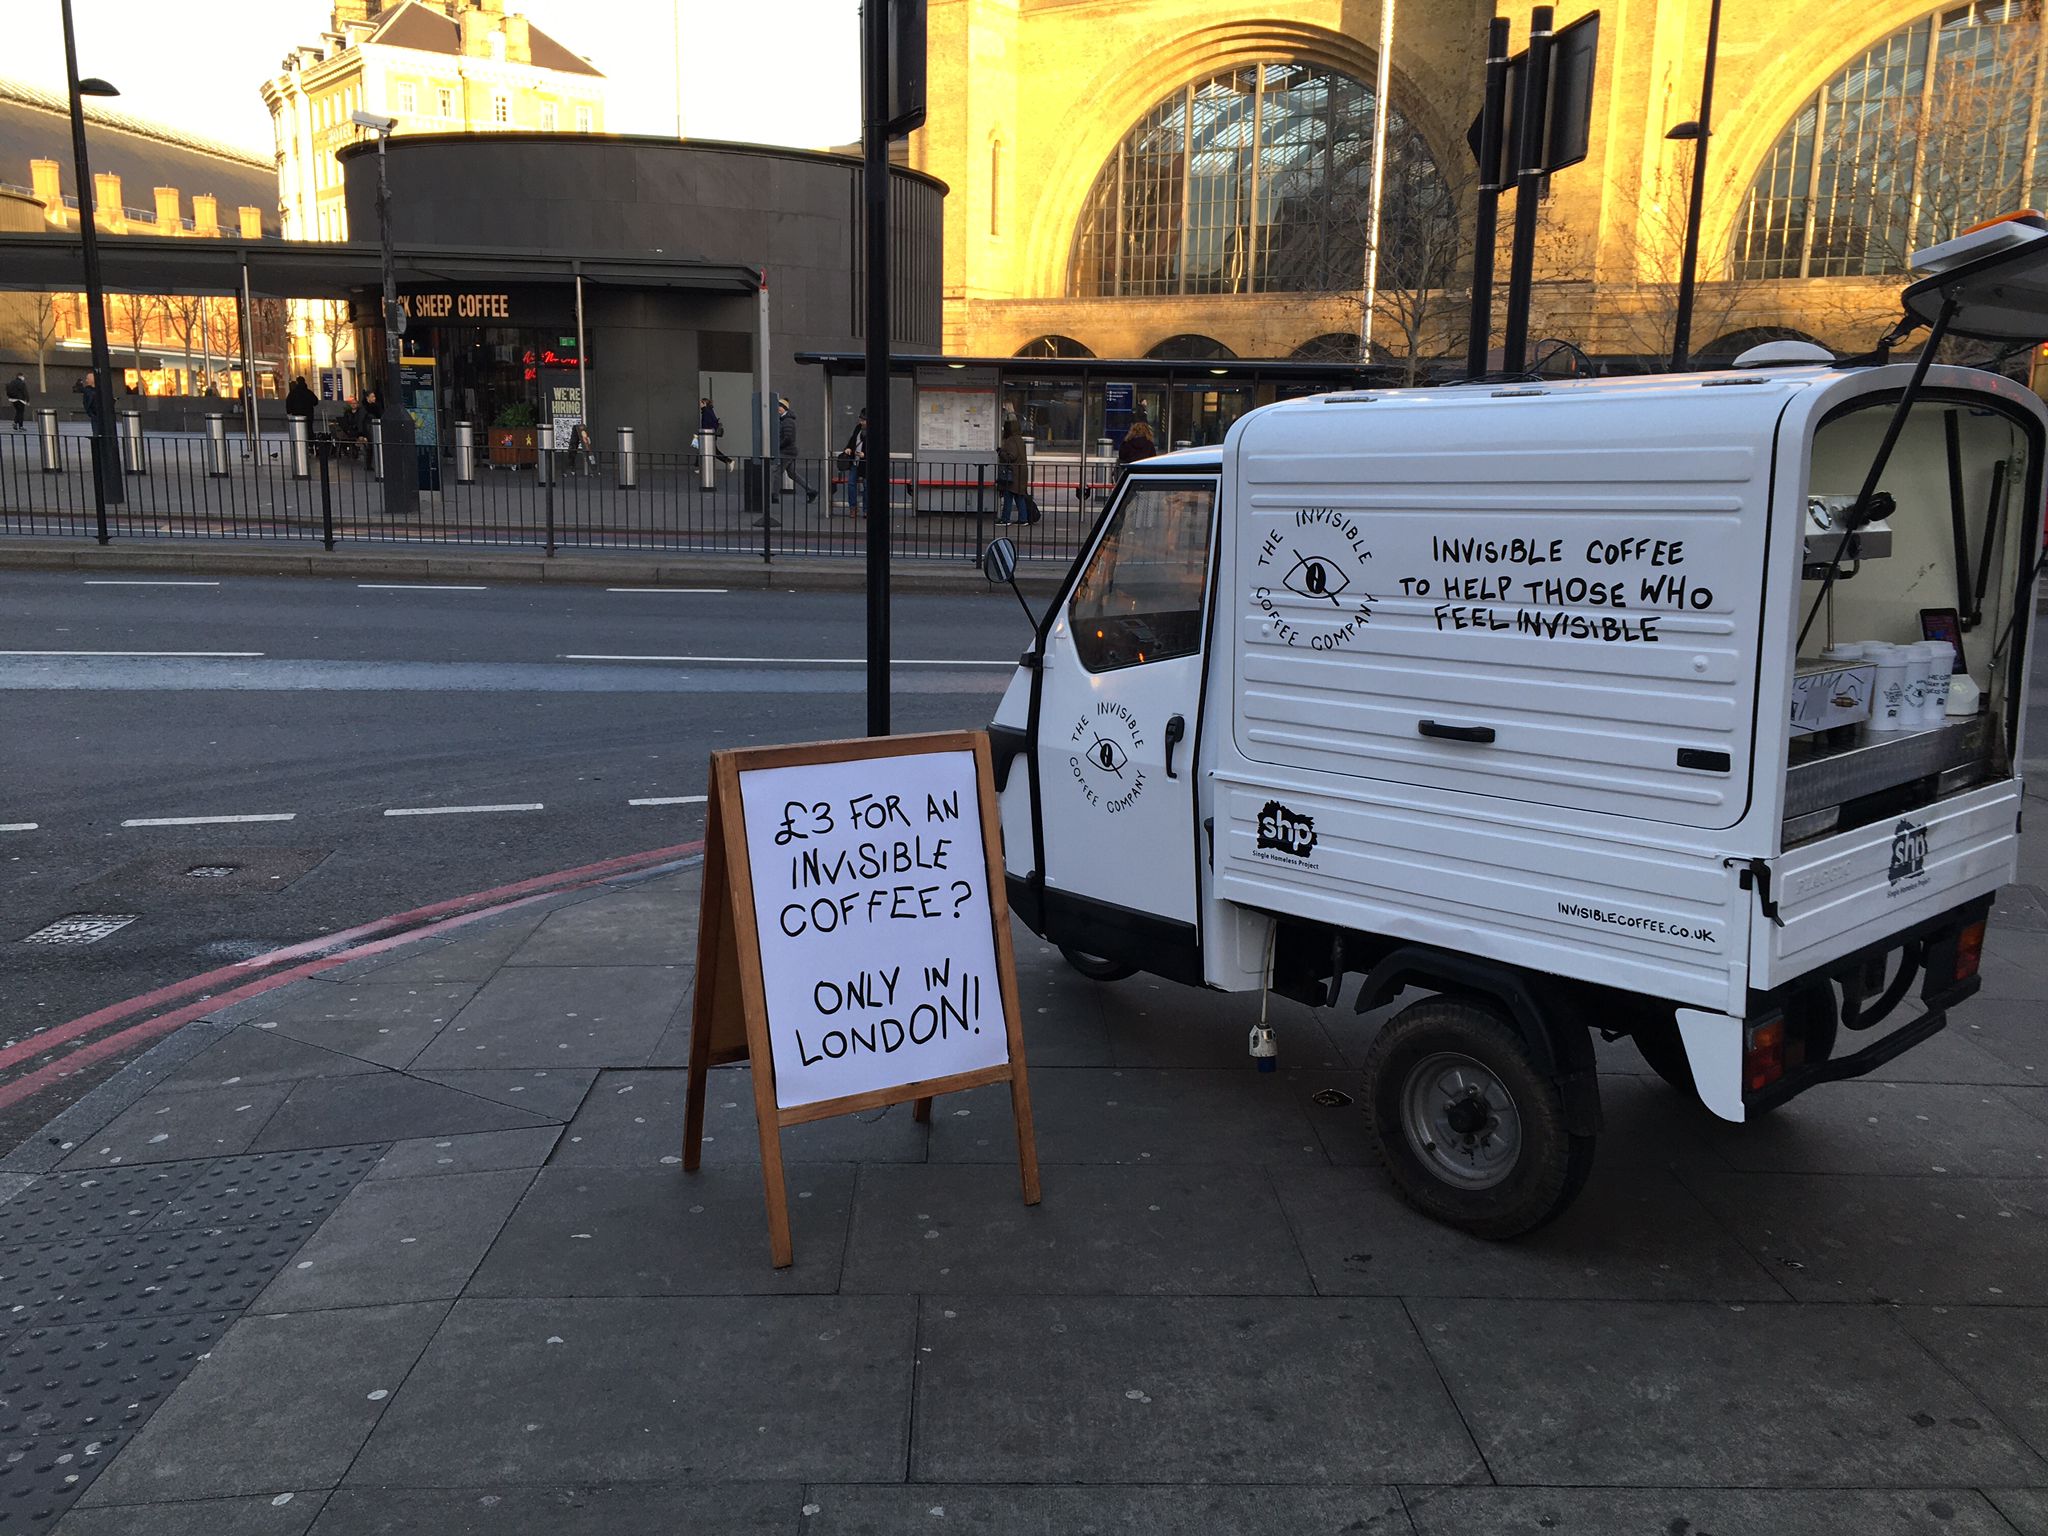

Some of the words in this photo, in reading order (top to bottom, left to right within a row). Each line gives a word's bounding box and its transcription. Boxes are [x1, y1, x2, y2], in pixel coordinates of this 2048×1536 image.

[415, 294, 453, 318] SHEEP
[457, 294, 510, 318] COFFEE
[551, 400, 581, 414] HIRING
[553, 387, 581, 401] WE'RE
[1257, 528, 1284, 567] THE
[1295, 507, 1373, 565] INVISIBLE
[1433, 535, 1563, 566] INVISIBLE
[1586, 537, 1684, 567] COFFEE
[1398, 576, 1431, 597] TO
[1443, 575, 1513, 602] HELP
[1522, 576, 1627, 610] THOSE
[1640, 574, 1715, 611] WHO
[1255, 586, 1300, 647] COFFEE
[1310, 591, 1379, 652] COMPANY
[1434, 603, 1510, 633] FEEL
[1515, 607, 1662, 643] INVISIBLE
[1071, 713, 1090, 742] THE
[1096, 701, 1145, 749] INVISIBLE
[1069, 756, 1100, 808] COFFEE
[1106, 769, 1147, 815] COMPANY
[774, 801, 835, 846] £3
[849, 793, 912, 831] FOR
[926, 790, 960, 824] AN
[1262, 812, 1314, 851] shp
[792, 834, 953, 890] INVISIBLE
[1252, 849, 1270, 860] Single
[1270, 853, 1298, 866] Homeless
[1298, 859, 1320, 870] Project
[1893, 828, 1928, 873] shp
[779, 879, 973, 938] COFFEE?
[1557, 902, 1717, 944] INVISIBLECOFFEE.CO.UK
[813, 966, 901, 1016] ONLY
[923, 957, 951, 993] IN
